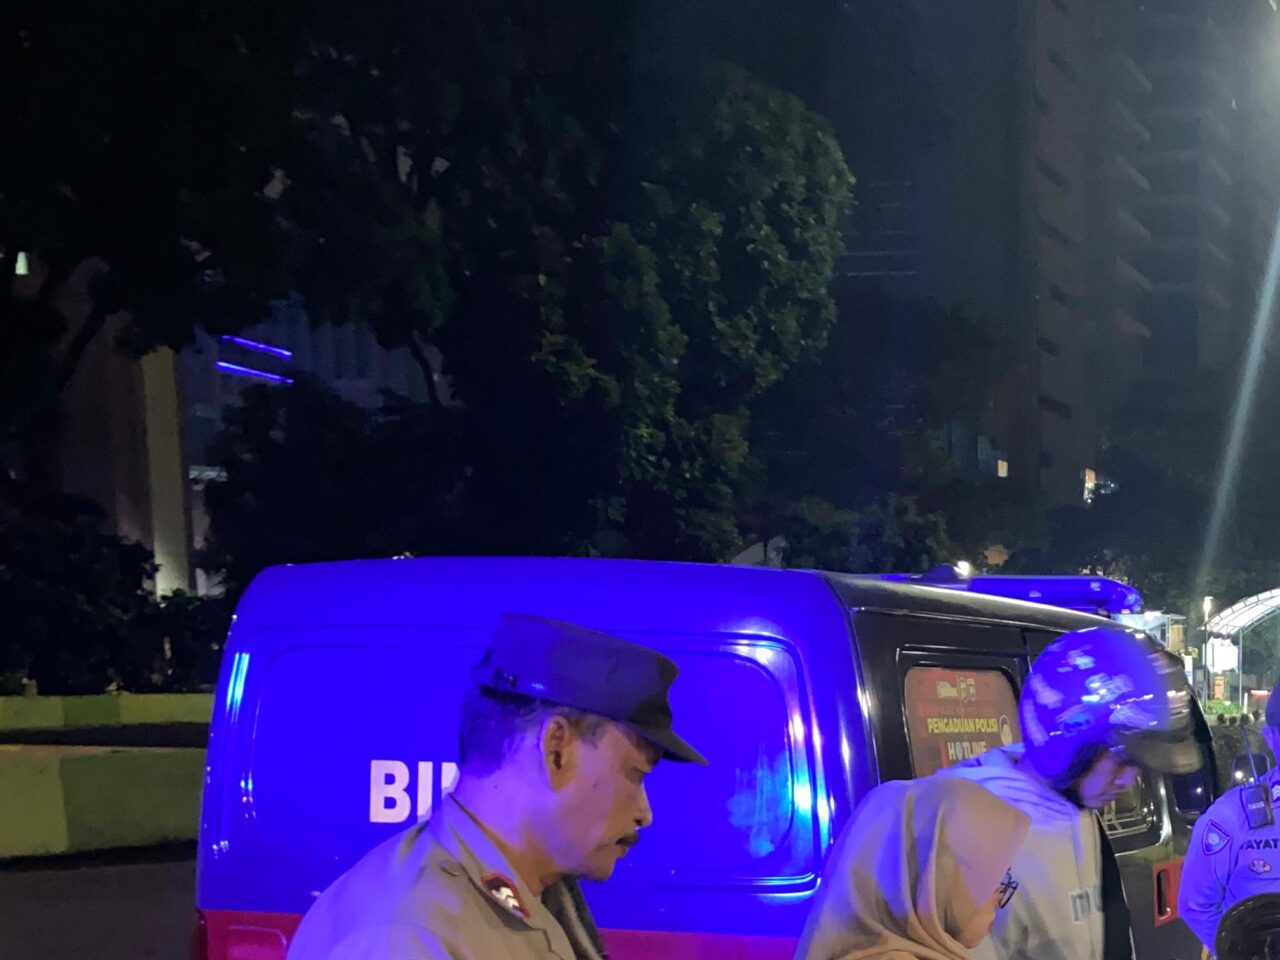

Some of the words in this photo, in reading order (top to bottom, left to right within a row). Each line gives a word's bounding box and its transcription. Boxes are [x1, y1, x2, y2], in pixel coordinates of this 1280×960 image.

[927, 718, 976, 734] PENGADUAN
[976, 718, 998, 733] POLISI
[1240, 838, 1280, 850] AYAT
